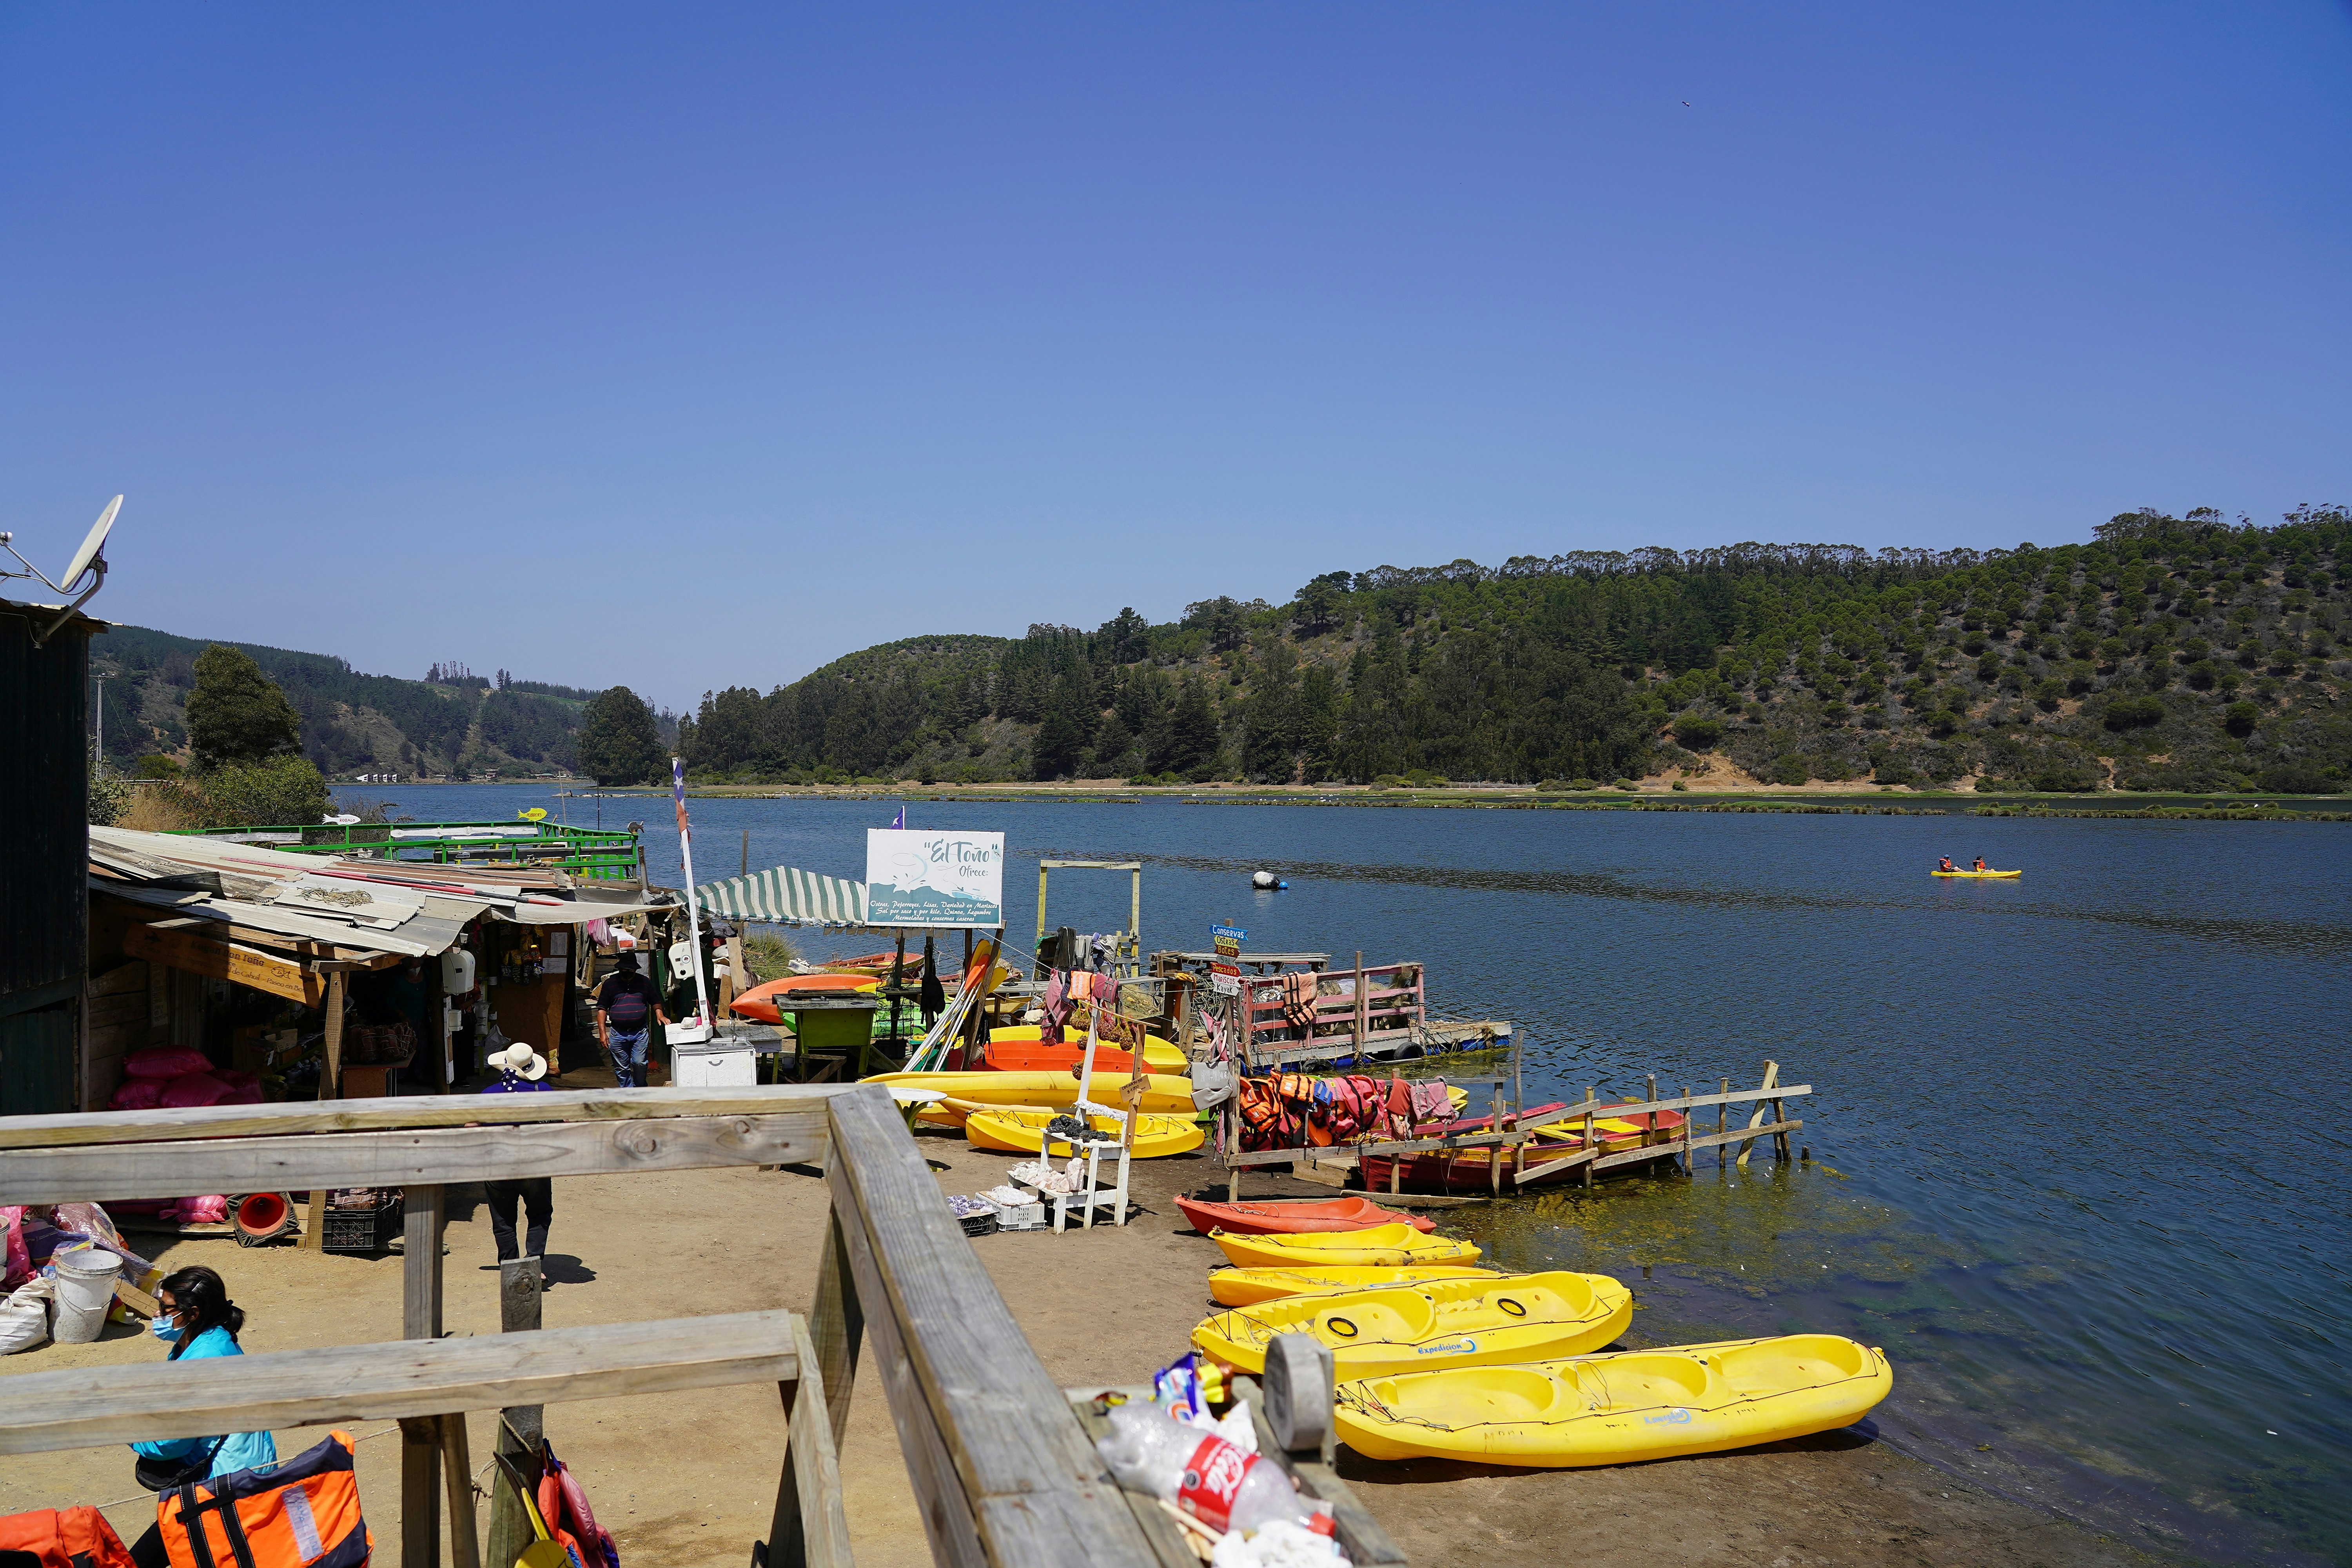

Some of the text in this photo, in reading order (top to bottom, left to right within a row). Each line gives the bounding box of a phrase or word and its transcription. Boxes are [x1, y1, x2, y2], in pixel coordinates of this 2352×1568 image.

[892, 900, 920, 909] Pejerreyes,
[1218, 946, 1234, 955] Botes
[1220, 956, 1230, 965] Sal
[1212, 964, 1237, 975] Pescados
[267, 978, 284, 987] Paseo
[1122, 1078, 1142, 1090] COCHAYUYO
[1418, 1343, 1462, 1354] Expedicion
